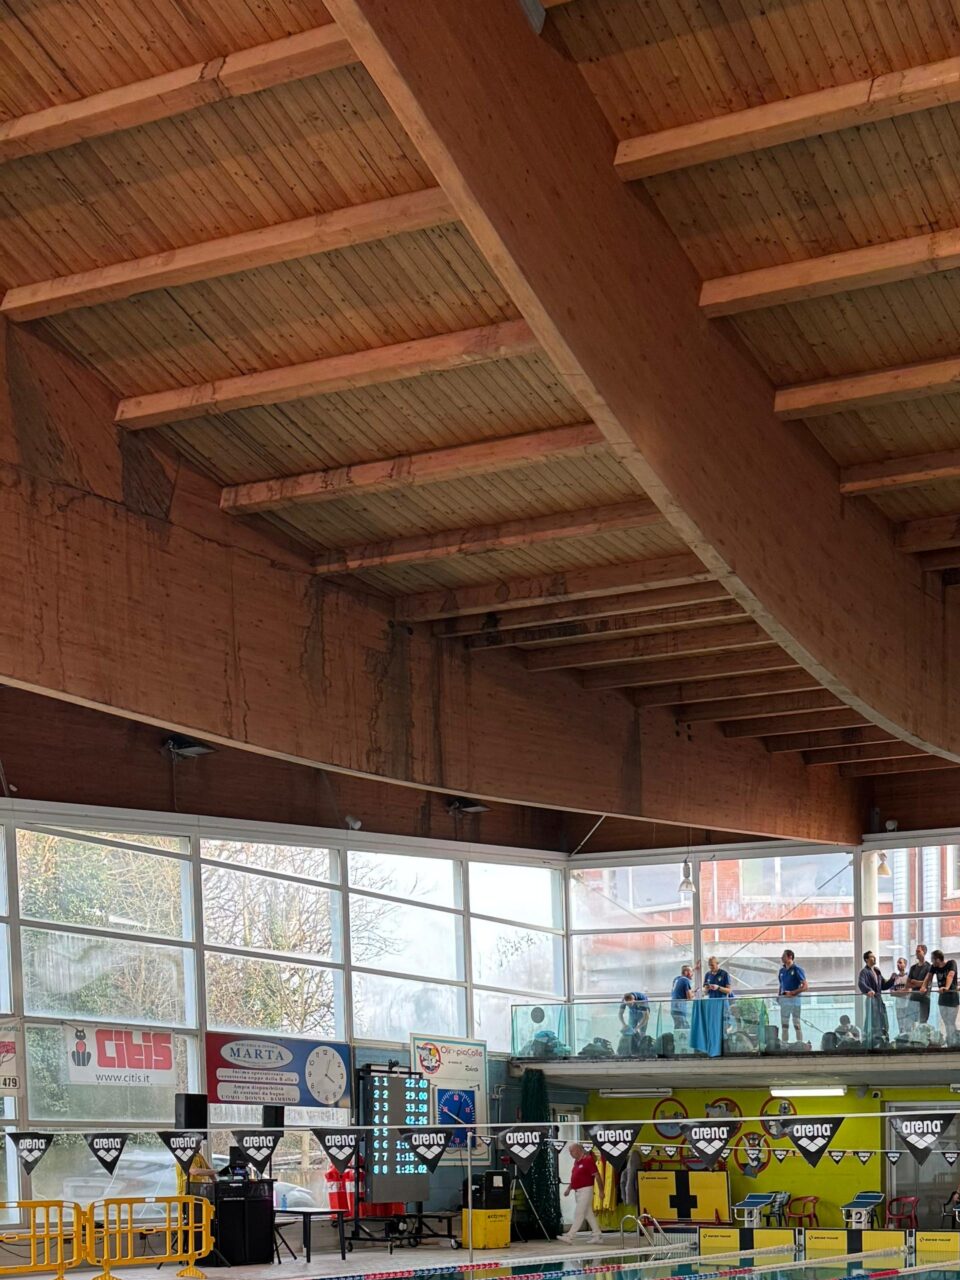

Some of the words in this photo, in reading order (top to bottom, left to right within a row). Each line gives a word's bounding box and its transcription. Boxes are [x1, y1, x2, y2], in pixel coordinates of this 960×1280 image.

[230, 1047, 284, 1060] MARTA
[2, 1077, 18, 1087] 479
[95, 1073, 150, 1083] www.citis.it
[373, 1078, 379, 1086] 1
[383, 1078, 388, 1086] 1
[405, 1079, 428, 1088] 22.40
[373, 1090, 379, 1098] 2
[383, 1090, 388, 1098] 2
[405, 1091, 428, 1100] 29.00
[373, 1103, 379, 1111] 3
[383, 1103, 388, 1111] 3
[405, 1104, 428, 1112] 33.58
[373, 1115, 379, 1123] 4
[383, 1115, 388, 1123] 4
[405, 1116, 428, 1125] 42.26
[373, 1128, 379, 1136] 5
[383, 1128, 388, 1136] 5
[793, 1123, 831, 1137] arena
[902, 1120, 942, 1134] arena
[505, 1131, 539, 1144] arena
[596, 1129, 630, 1142] arena
[691, 1127, 728, 1139] arena
[19, 1138, 45, 1149] arena
[93, 1137, 121, 1149] arena
[170, 1137, 196, 1148] arena
[243, 1135, 273, 1147] arena
[325, 1135, 356, 1146] arena
[411, 1133, 445, 1145] arena
[373, 1141, 379, 1149] 6
[383, 1141, 388, 1149] 6
[373, 1153, 379, 1161] 7
[383, 1153, 388, 1161] 7
[396, 1153, 418, 1161] 1:15.
[373, 1165, 379, 1174] 8
[383, 1165, 388, 1174] 8
[396, 1165, 427, 1173] 1:25.02
[855, 1211, 862, 1223] 2
